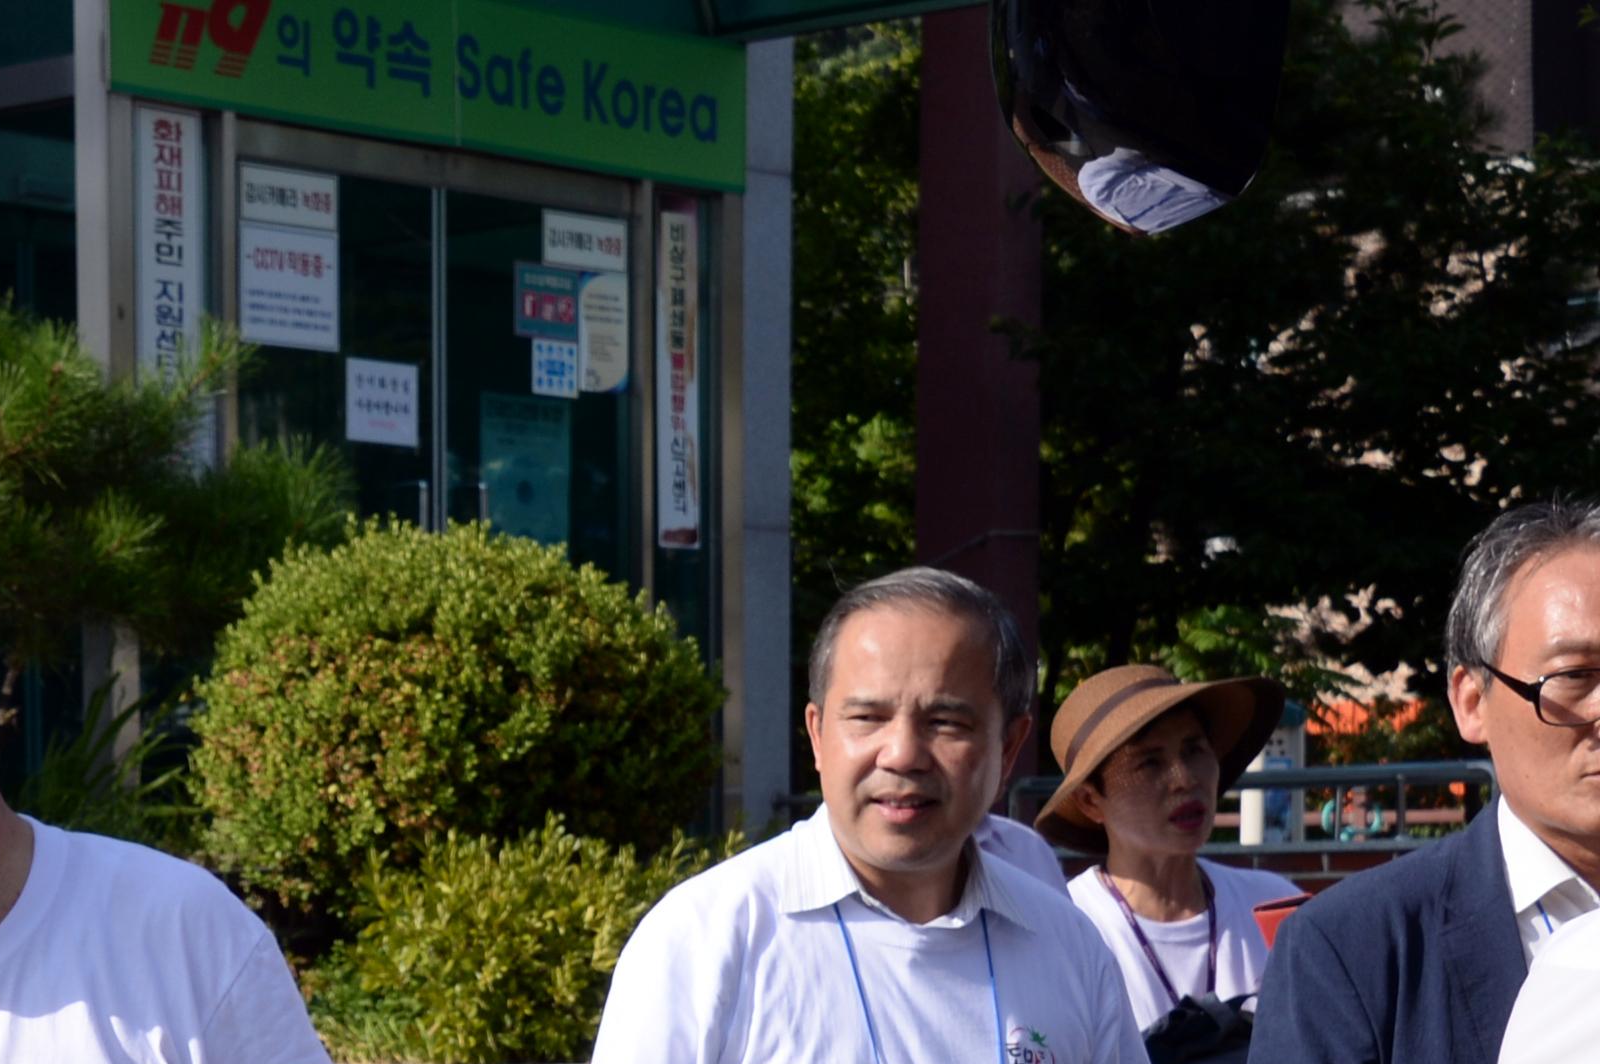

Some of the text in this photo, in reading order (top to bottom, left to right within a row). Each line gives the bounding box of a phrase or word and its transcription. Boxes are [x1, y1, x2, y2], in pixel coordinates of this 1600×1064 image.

[332, 8, 432, 97] 약속
[456, 35, 567, 115] Safe
[583, 59, 719, 143] Korea
[153, 117, 183, 267] 화재피해주민
